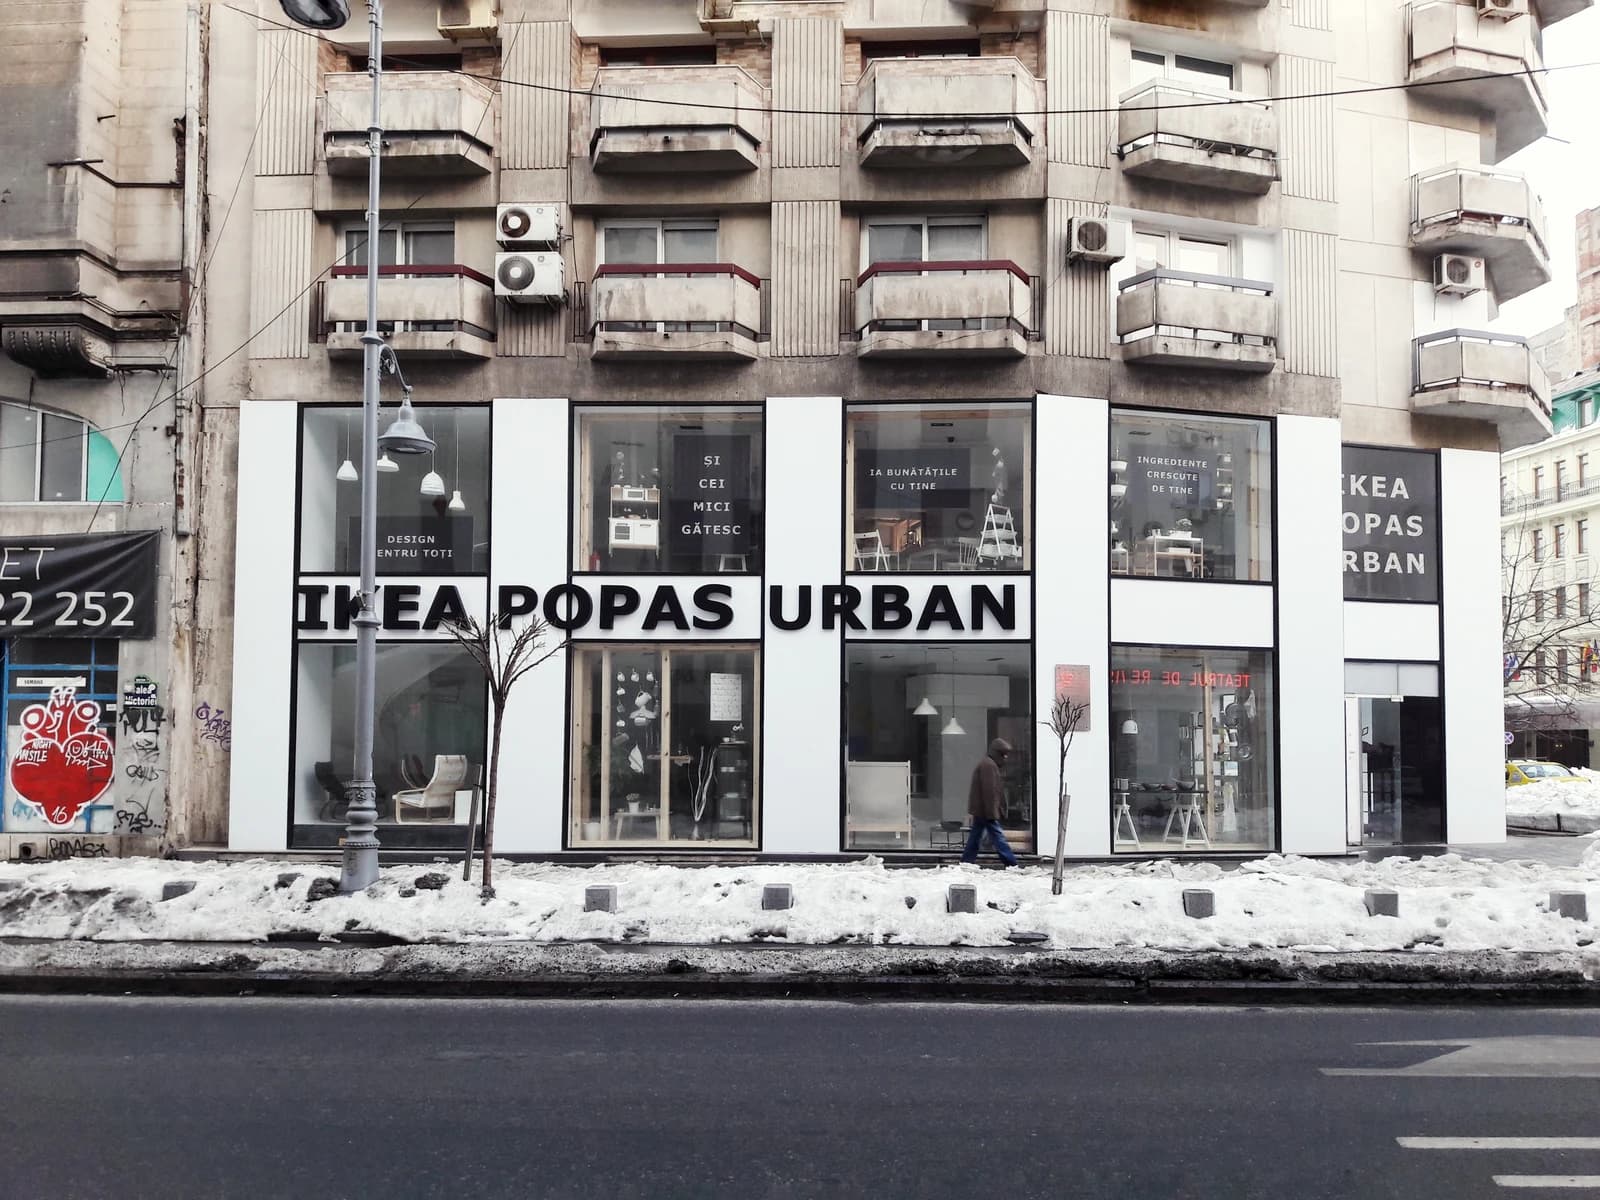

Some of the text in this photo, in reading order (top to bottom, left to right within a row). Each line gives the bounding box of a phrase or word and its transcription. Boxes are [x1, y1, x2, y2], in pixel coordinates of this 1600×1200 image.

[1137, 456, 1208, 469] INGREDIENTE
[870, 468, 882, 476] IA
[1147, 470, 1199, 481] CRESCUTE
[698, 478, 725, 489] CEI
[890, 482, 937, 490] CU TINE
[1152, 484, 1193, 495] DE TINE
[1341, 474, 1410, 499] KEA
[693, 501, 731, 512] MICI
[681, 522, 741, 535] GĂTESC
[1341, 511, 1424, 537] OPAS
[387, 535, 435, 544] DESIGN
[376, 549, 418, 558] ENTRU
[1342, 550, 1425, 575] RBAN
[55, 591, 135, 627] 252
[498, 583, 735, 631] POPAS
[768, 584, 1016, 631] URBAN
[51, 806, 68, 824] 16
